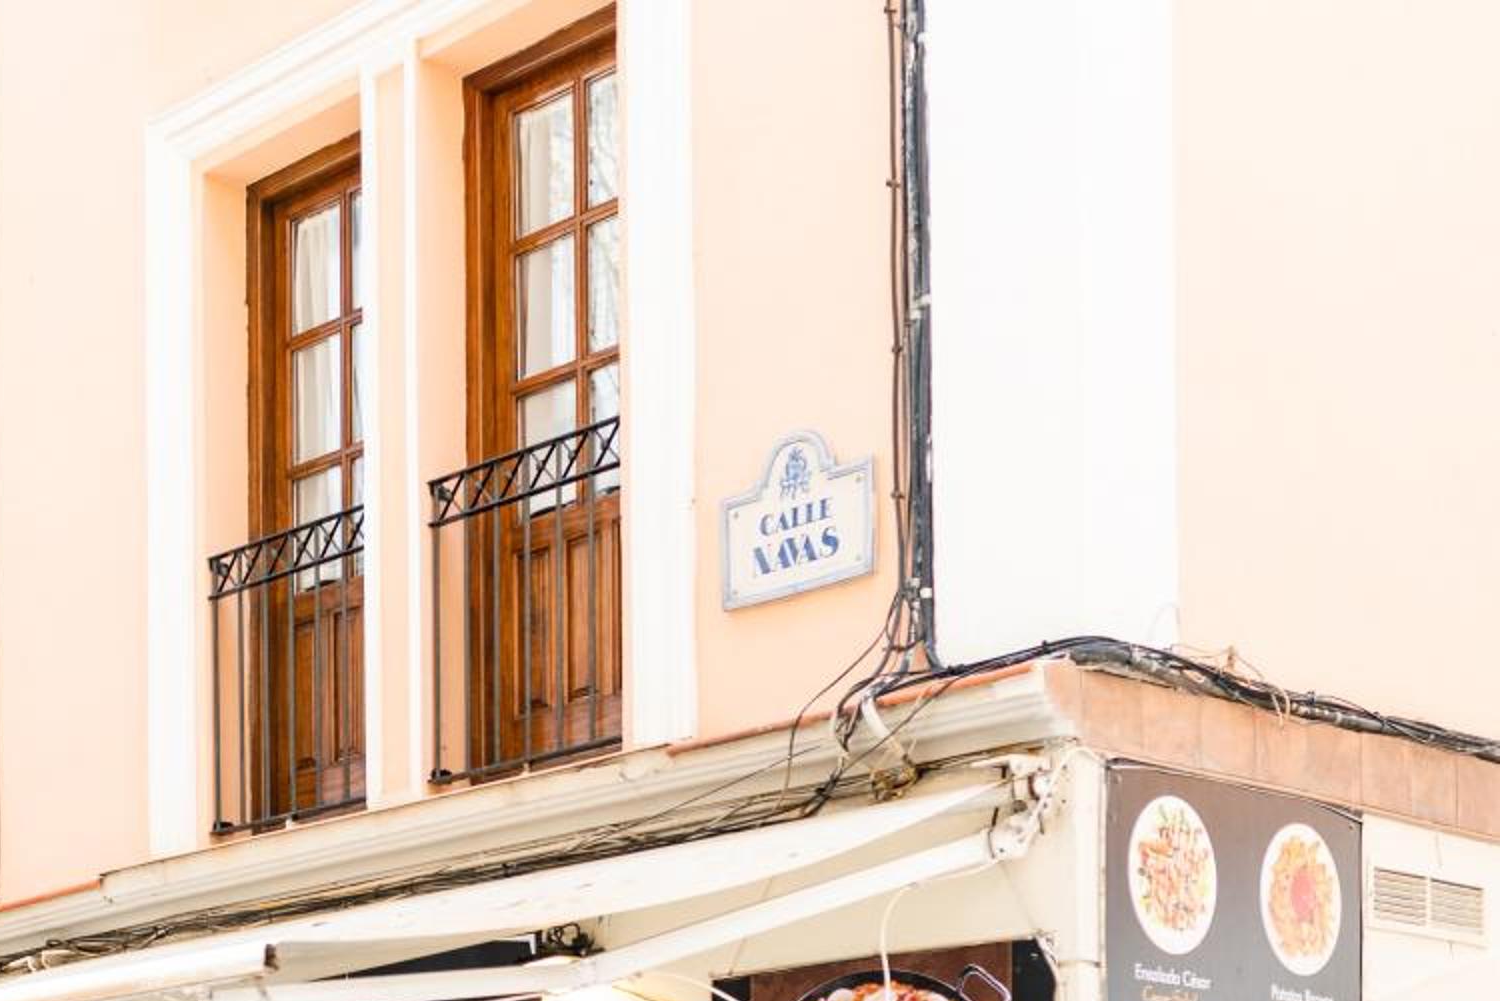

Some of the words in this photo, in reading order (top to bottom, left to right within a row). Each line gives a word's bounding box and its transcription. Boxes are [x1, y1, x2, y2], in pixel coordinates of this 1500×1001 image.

[760, 497, 833, 537] CALLE
[753, 527, 839, 578] NAVAS
[1134, 963, 1181, 985] Ensalada
